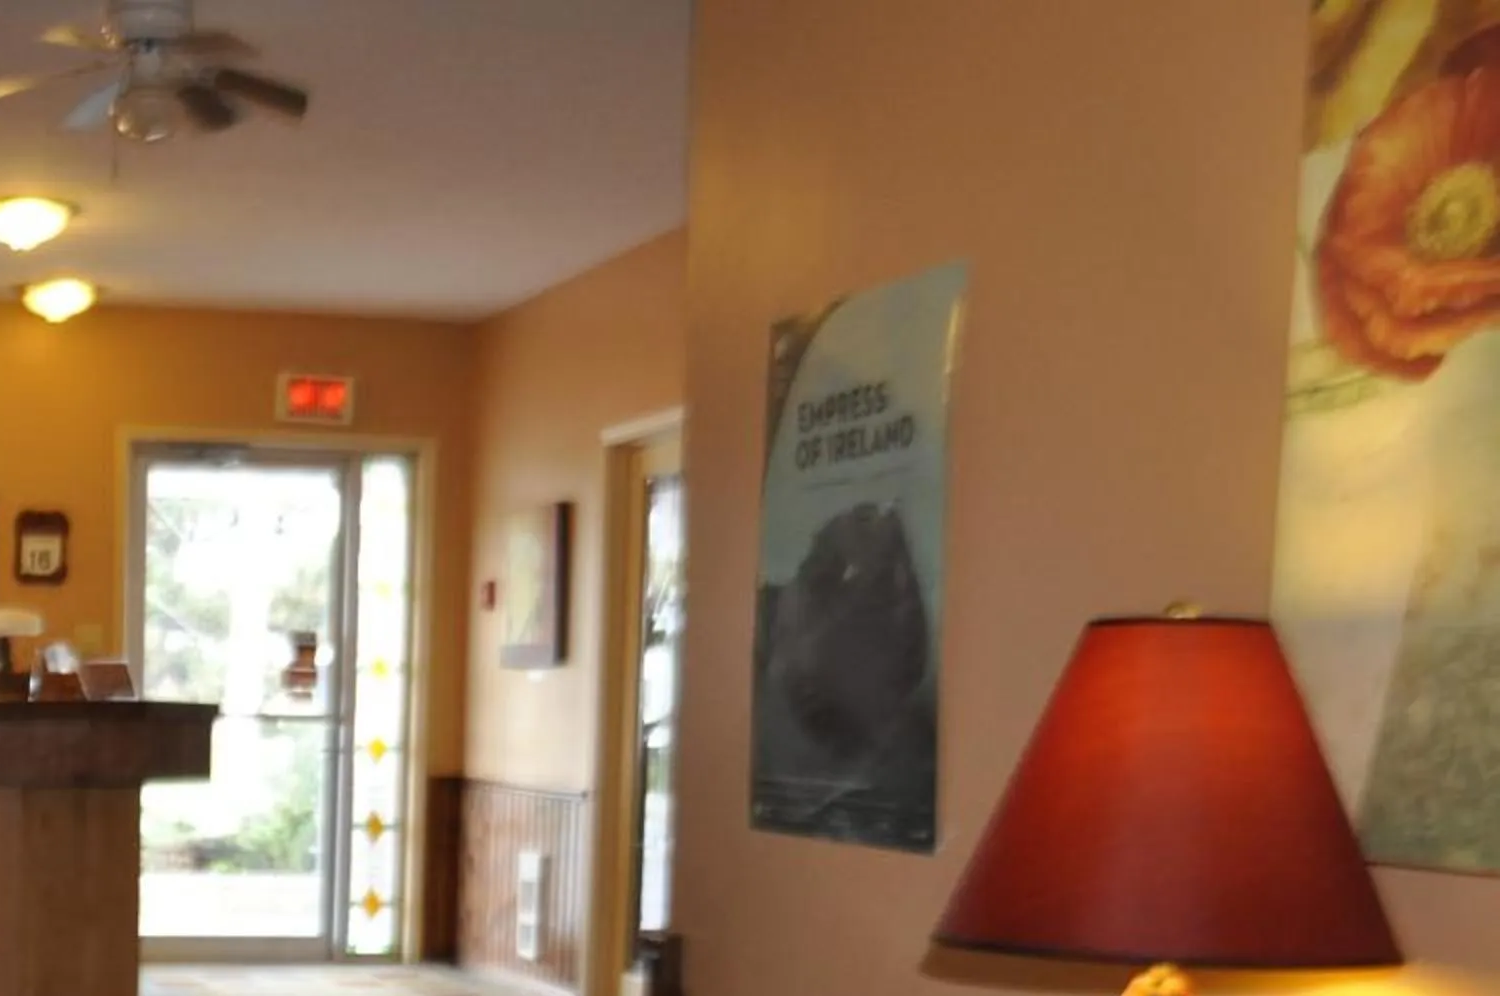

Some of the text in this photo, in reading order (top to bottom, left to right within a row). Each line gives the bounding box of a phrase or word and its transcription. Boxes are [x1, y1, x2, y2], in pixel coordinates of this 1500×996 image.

[797, 381, 888, 434] EMPRESS
[795, 414, 915, 472] OF IRELAND
